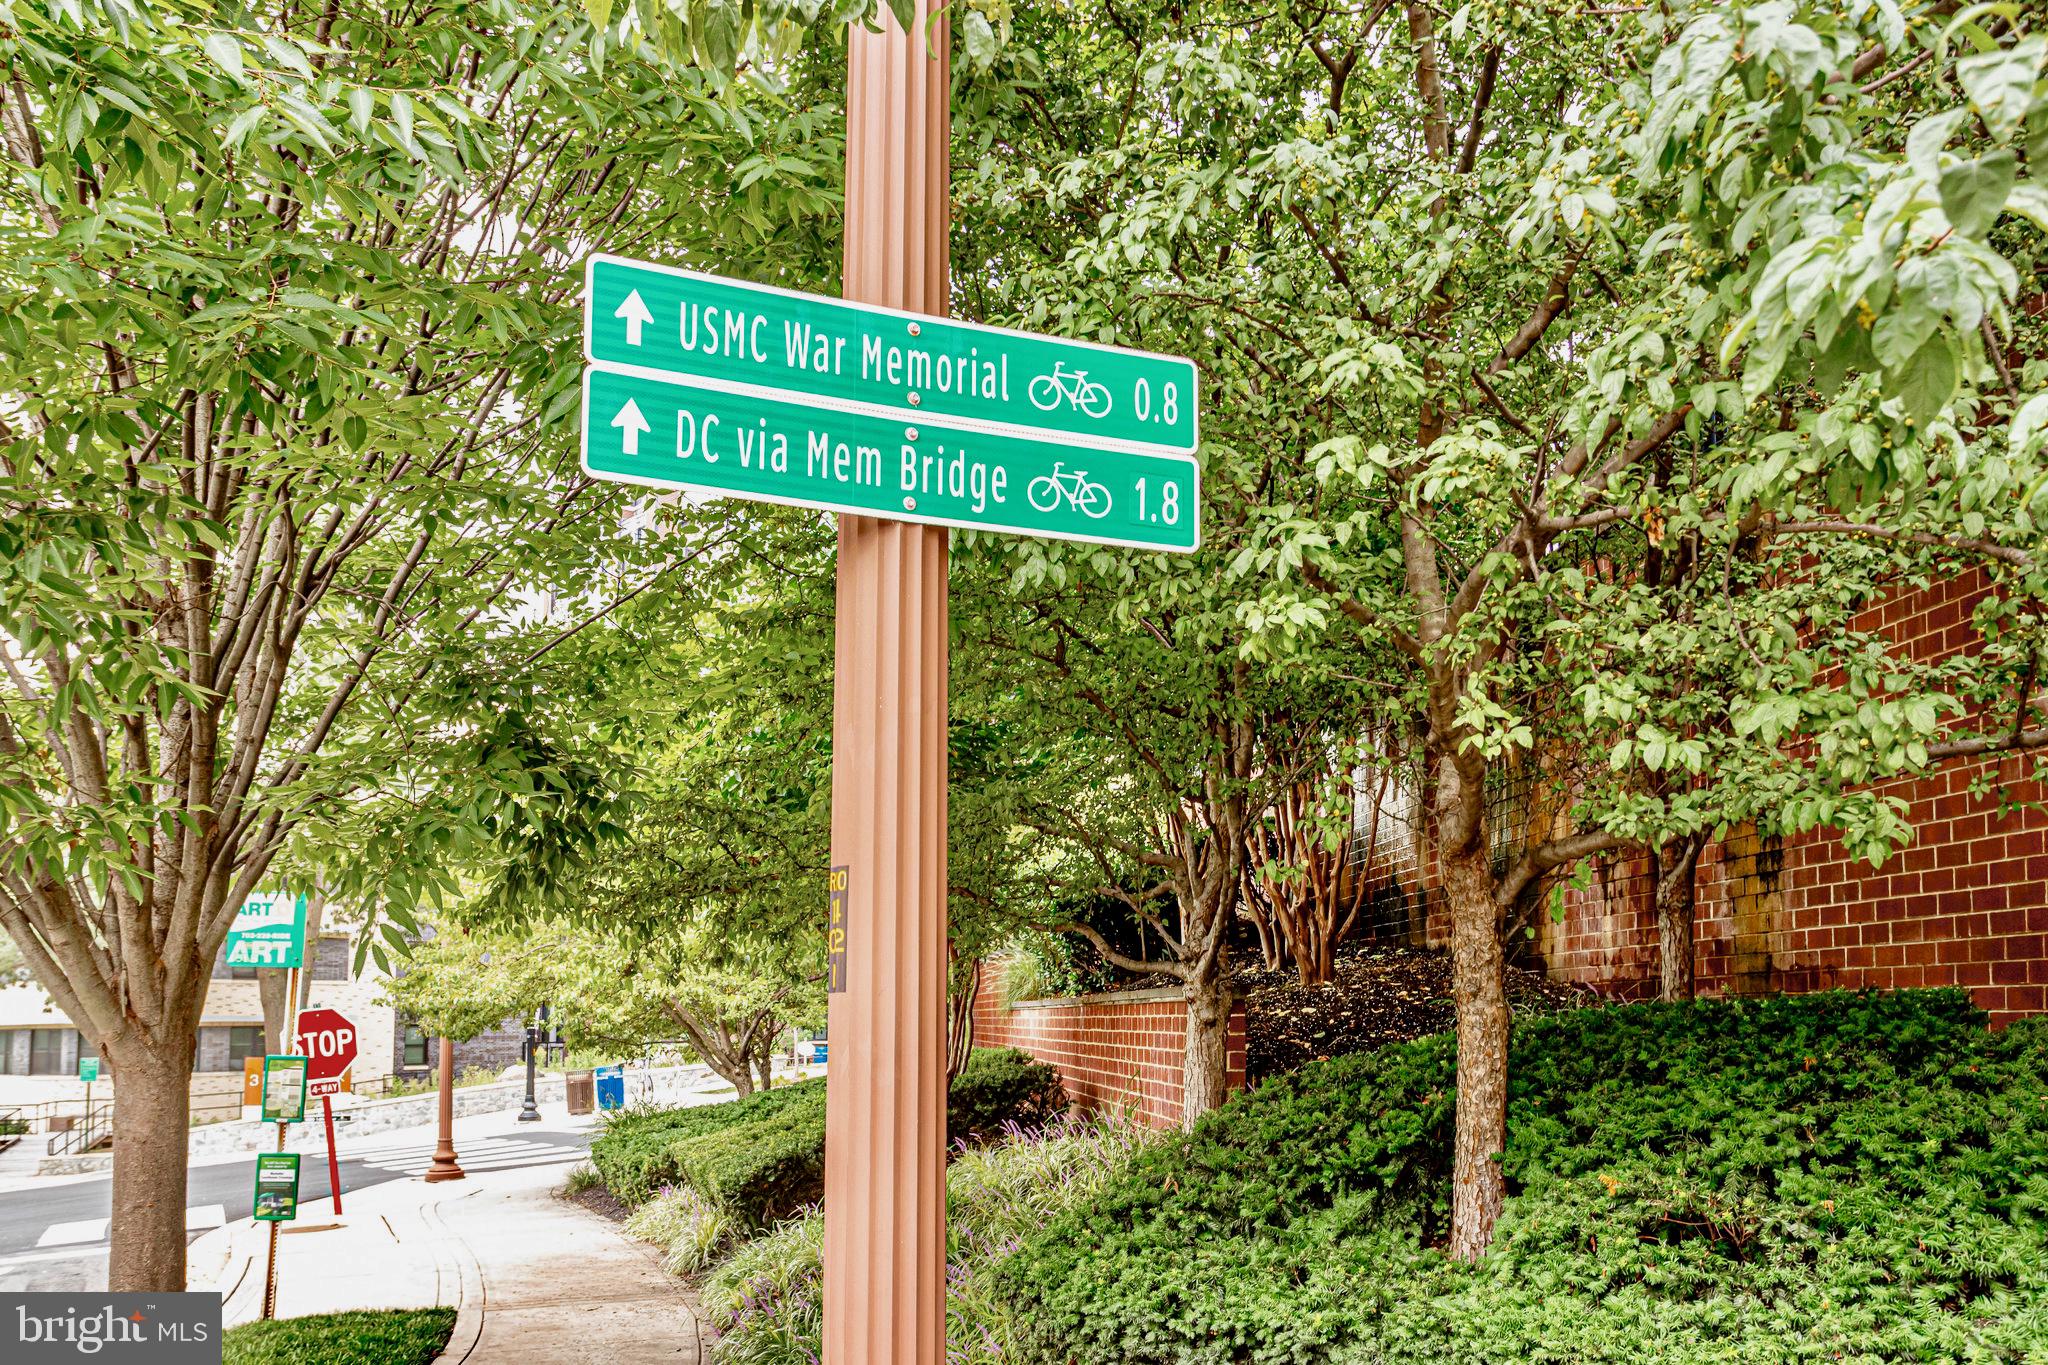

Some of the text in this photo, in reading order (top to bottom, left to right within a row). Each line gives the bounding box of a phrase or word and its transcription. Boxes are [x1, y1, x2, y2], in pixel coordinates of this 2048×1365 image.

[678, 301, 1179, 426] USMC War Memorial 0.8
[676, 409, 1180, 526] DC via Mem Bridge 1.8
[227, 940, 293, 963] ART
[291, 1028, 353, 1059] STOP
[249, 1074, 259, 1087] 3
[311, 1082, 338, 1095] 4-WAY
